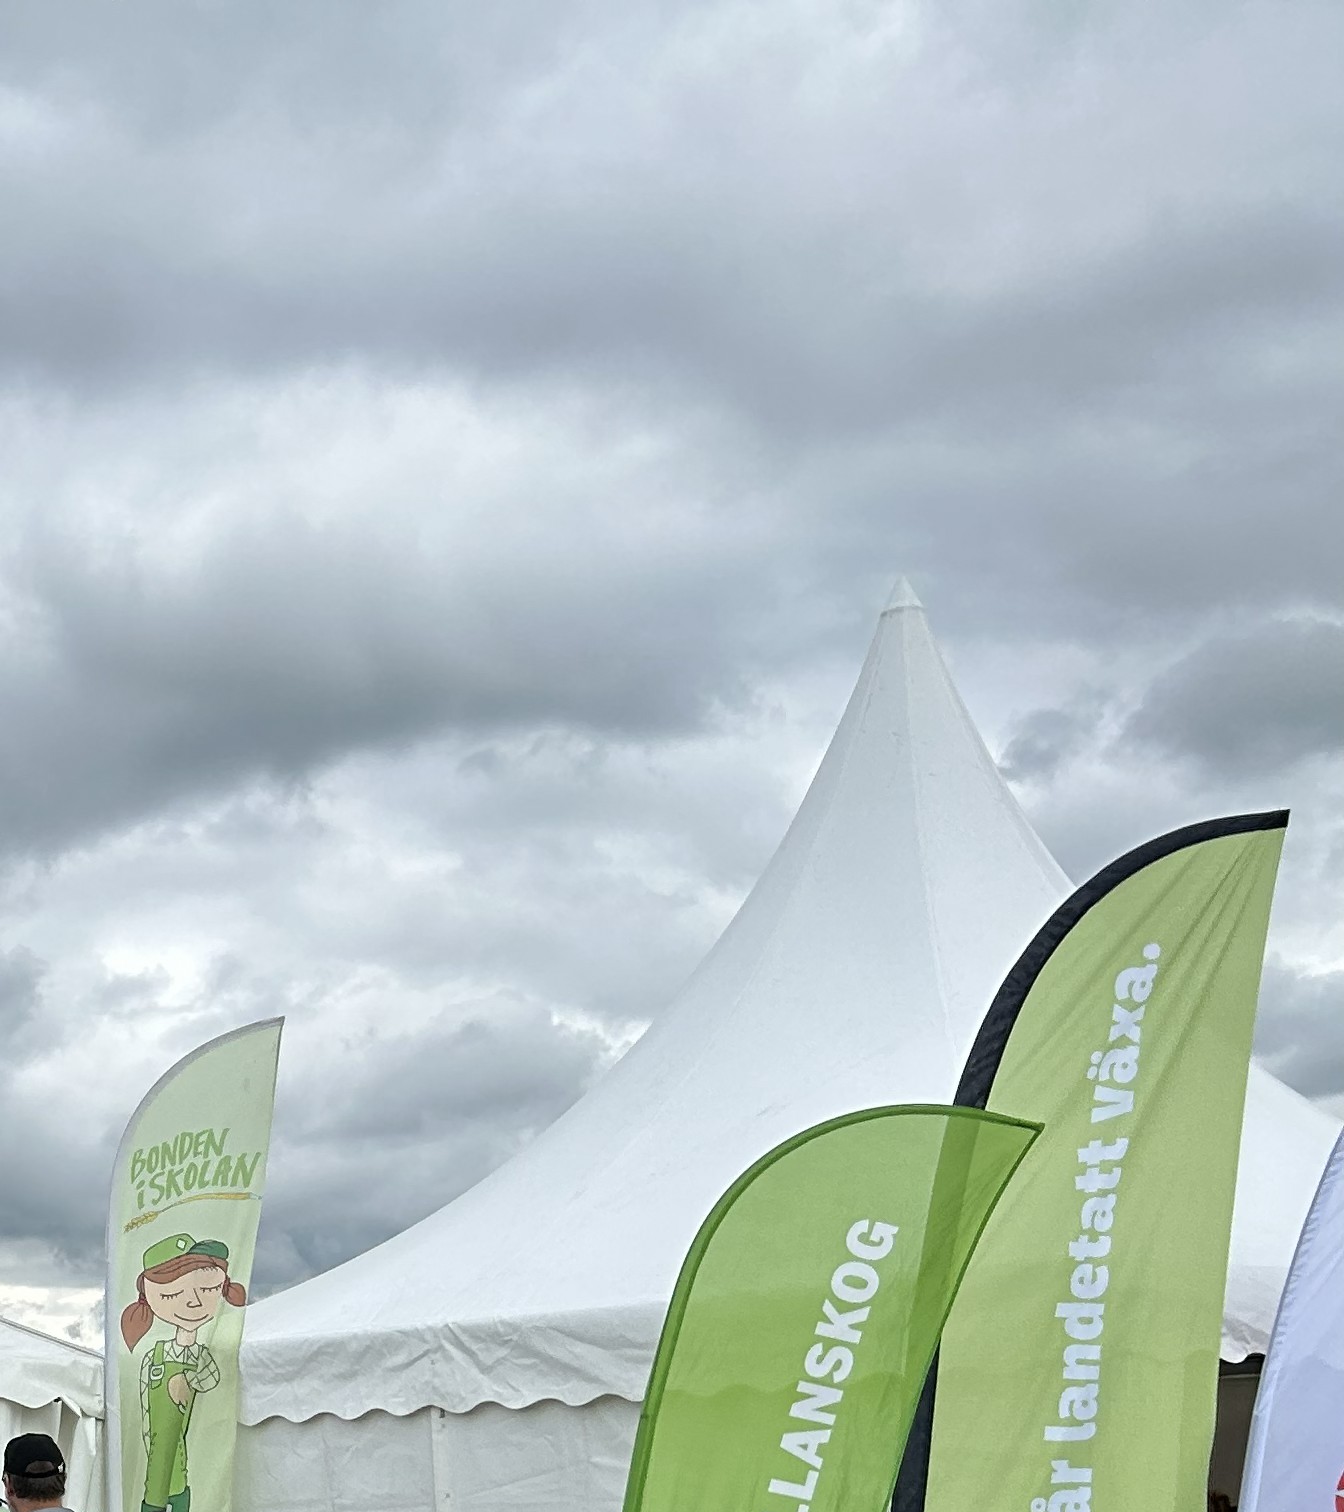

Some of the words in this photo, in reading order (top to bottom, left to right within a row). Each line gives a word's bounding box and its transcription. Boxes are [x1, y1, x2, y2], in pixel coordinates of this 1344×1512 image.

[1087, 943, 1161, 1123] växa.
[131, 1128, 231, 1184] BONDEN
[149, 1152, 261, 1206] SKOLAN
